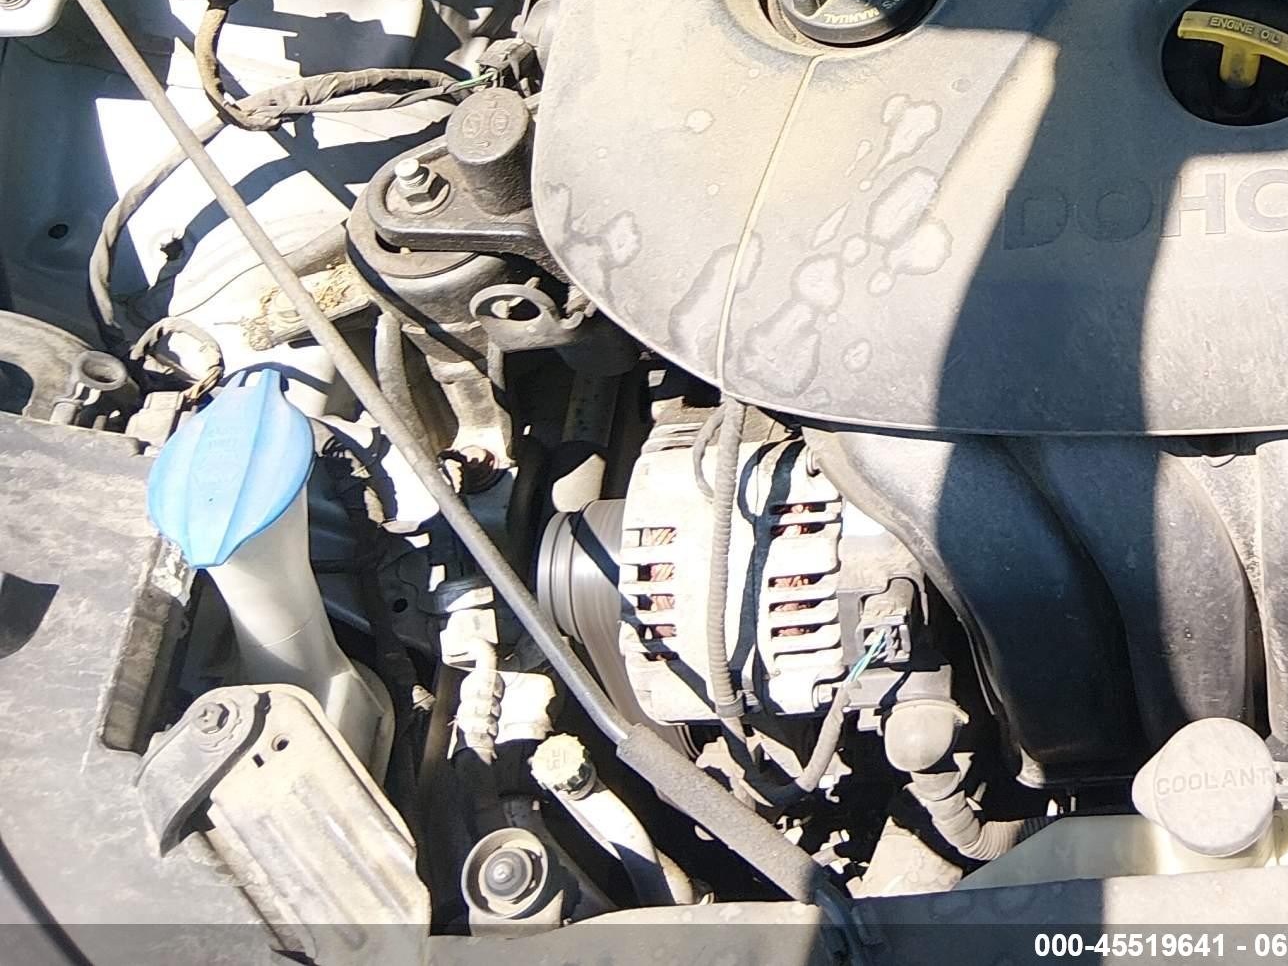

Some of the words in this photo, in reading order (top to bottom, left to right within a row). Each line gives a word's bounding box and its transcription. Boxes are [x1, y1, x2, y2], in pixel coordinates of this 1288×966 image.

[823, 6, 880, 24] MANUAL
[1209, 16, 1254, 34] ENGINE
[1260, 30, 1281, 44] OIL
[1155, 765, 1271, 796] COOLANT
